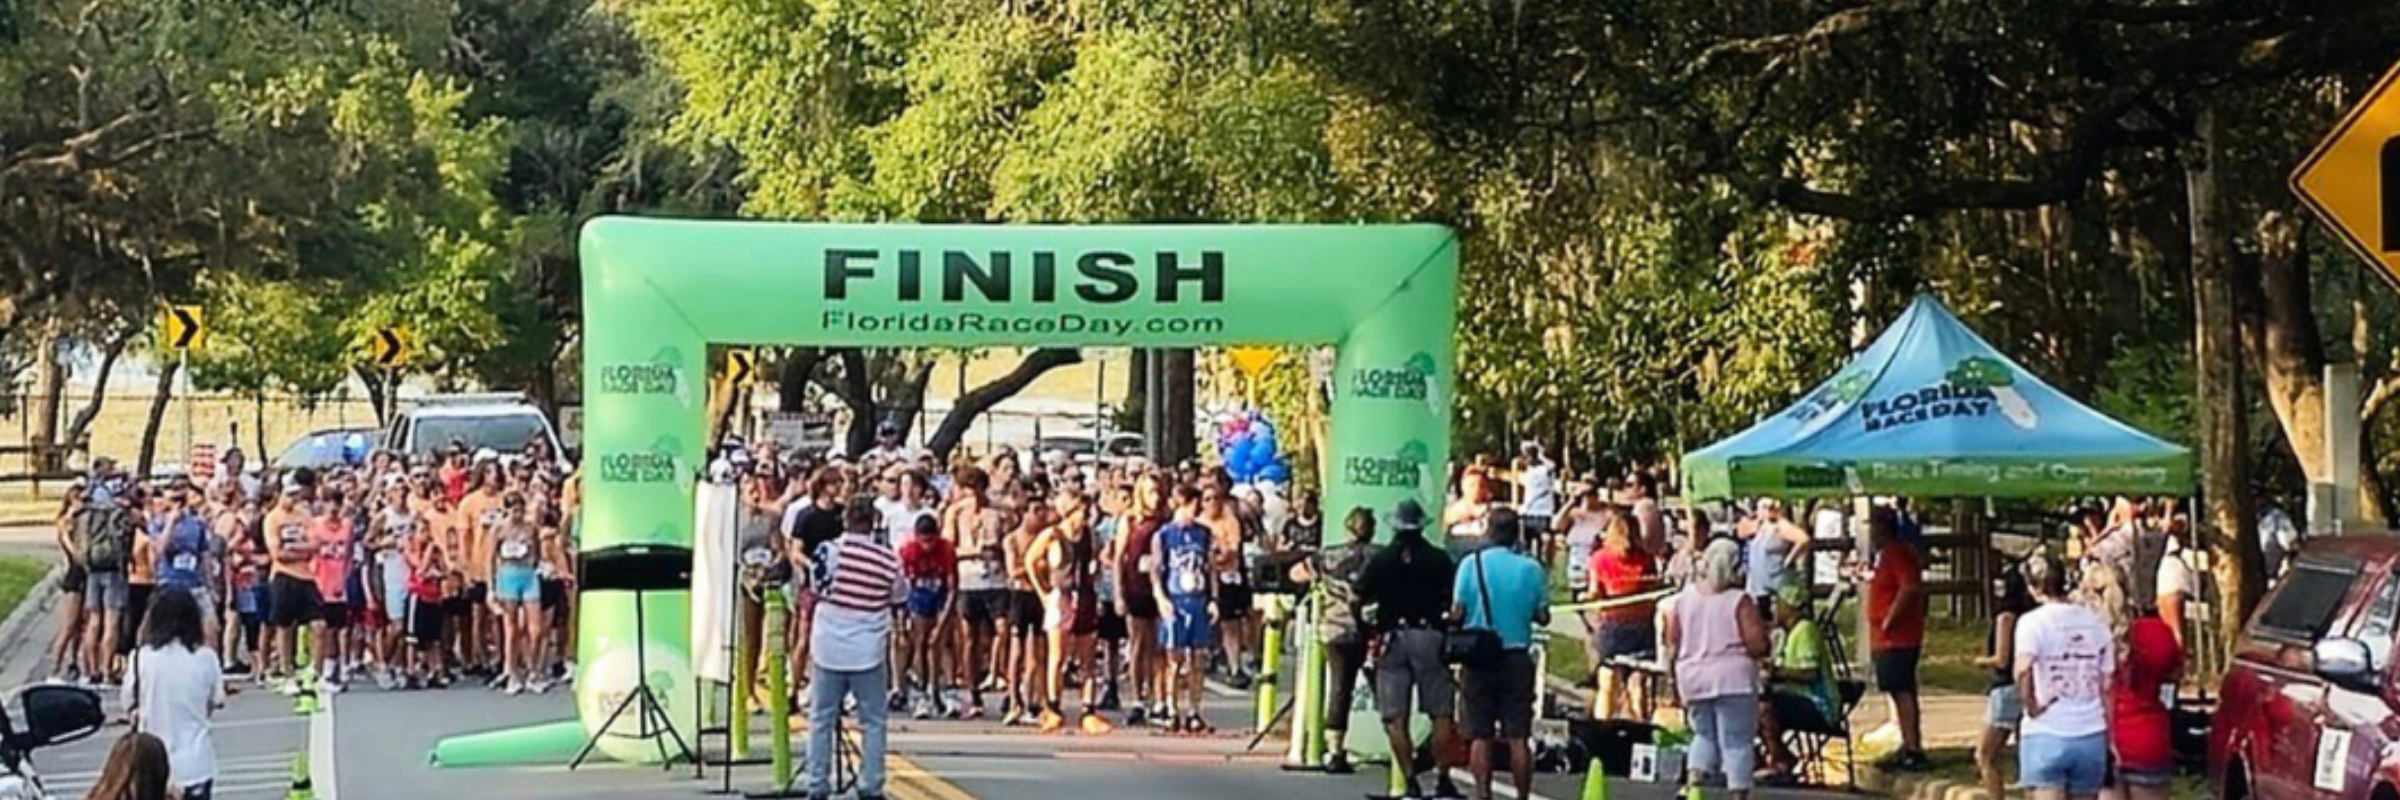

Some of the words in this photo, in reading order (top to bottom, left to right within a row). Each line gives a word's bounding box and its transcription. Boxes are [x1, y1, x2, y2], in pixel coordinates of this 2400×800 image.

[823, 248, 1226, 303] FINISH
[822, 310, 1225, 338] FloridaRaceDay.com
[1861, 384, 1997, 418] FLORIDA
[1871, 461, 1924, 480] Race
[1928, 459, 1999, 484] Timing
